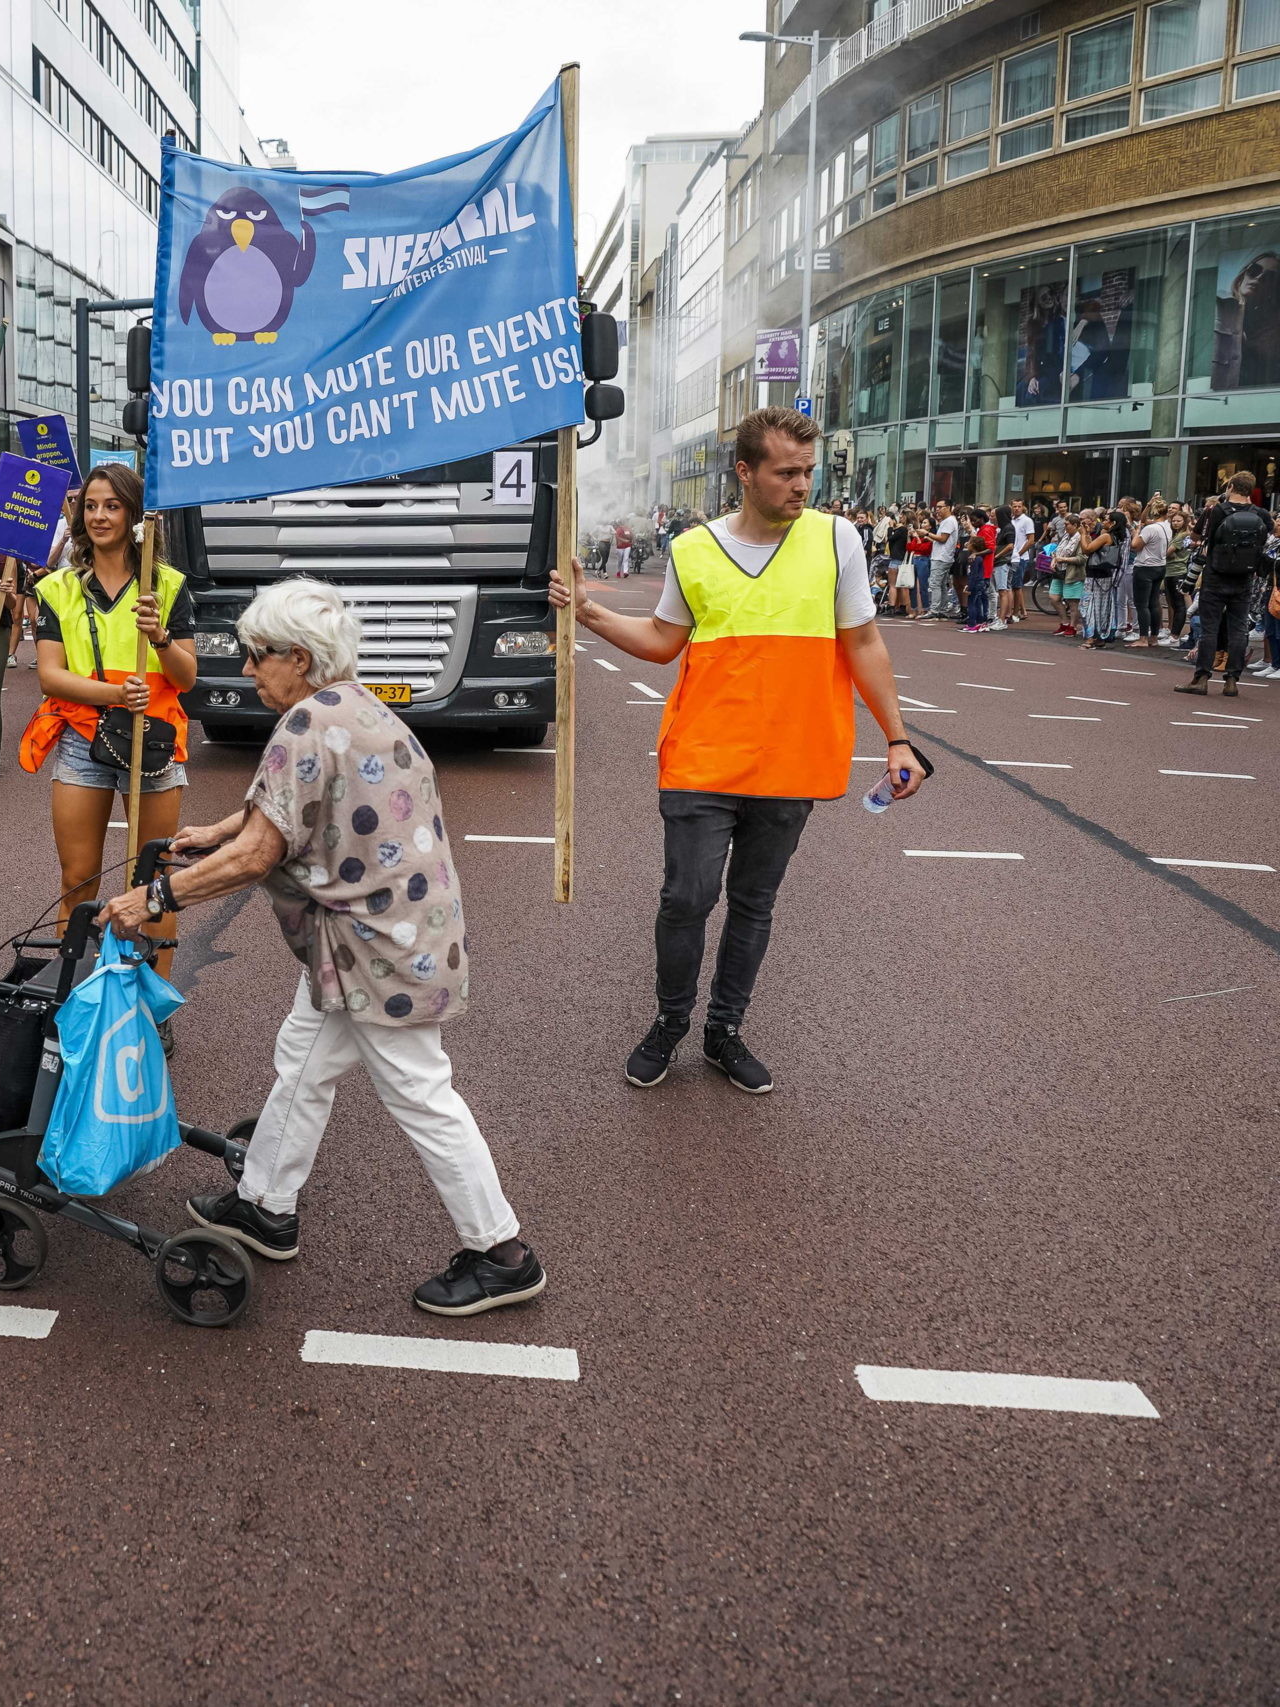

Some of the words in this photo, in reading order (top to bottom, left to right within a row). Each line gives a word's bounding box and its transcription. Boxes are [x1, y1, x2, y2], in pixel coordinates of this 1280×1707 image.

[387, 245, 488, 300] INTERFESTIVAL
[151, 377, 213, 419] YOU
[227, 376, 294, 416] CAN
[303, 345, 396, 406] MUTE
[405, 333, 460, 379] OUR
[467, 295, 581, 365] EVENTS
[170, 427, 234, 468] BUT
[247, 411, 315, 458] YOU
[326, 390, 418, 445] CAN'T
[430, 364, 527, 424] MUTE
[531, 344, 584, 390] US!
[799, 400, 808, 413] P
[36, 442, 57, 450] Minder
[499, 458, 527, 498] 4
[11, 490, 42, 506] Minder
[4, 501, 43, 519] grappen,
[18, 514, 49, 531] house!
[368, 686, 406, 699] P-37
[19, 1189, 42, 1204] TROJA
